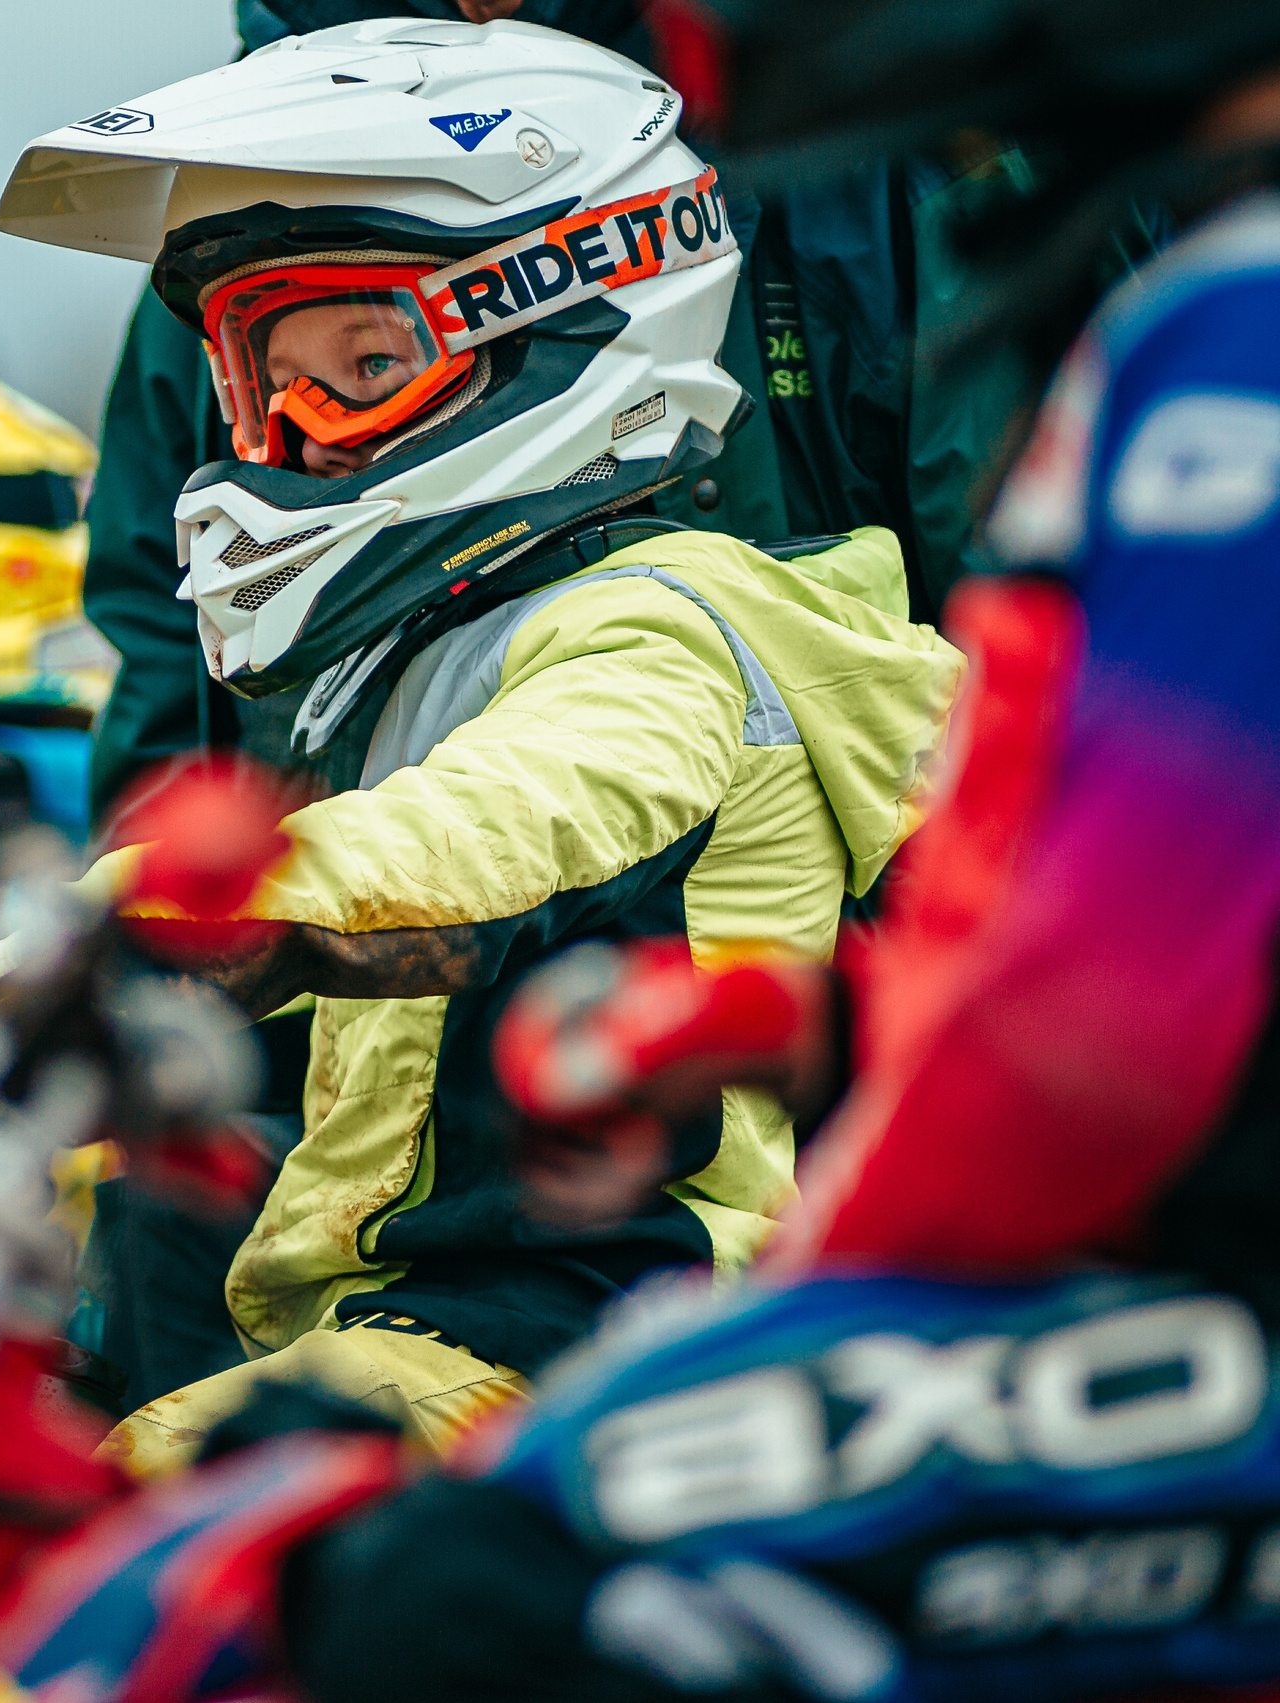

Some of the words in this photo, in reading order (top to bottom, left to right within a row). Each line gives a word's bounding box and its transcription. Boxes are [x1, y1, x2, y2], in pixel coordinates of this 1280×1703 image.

[631, 97, 676, 142] VFX-WR
[448, 222, 617, 333] RIDE
[613, 203, 666, 269] IT
[449, 535, 493, 564] EMERGENCY
[492, 528, 509, 540] USE
[508, 519, 527, 533] ONLY
